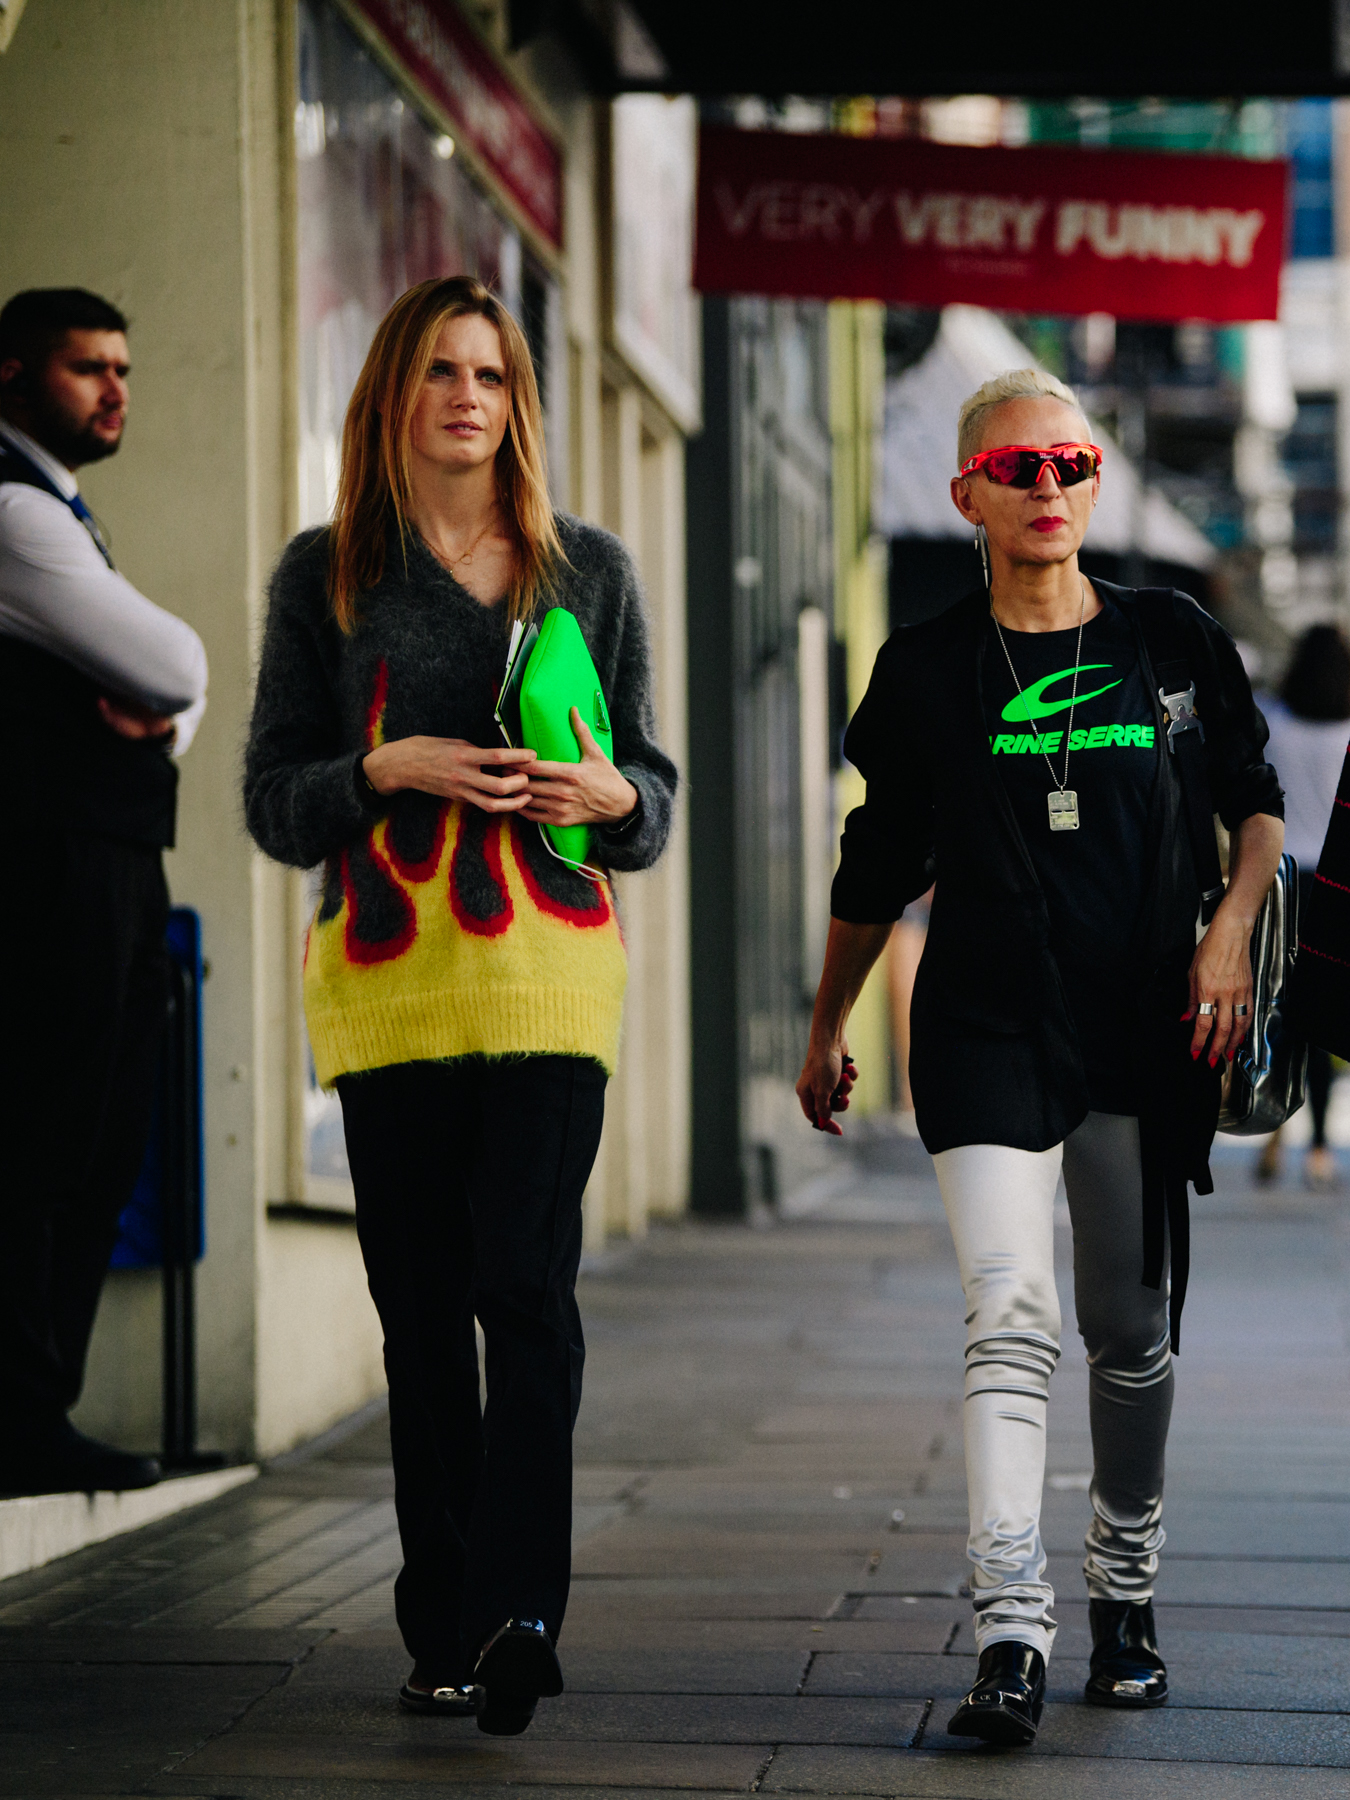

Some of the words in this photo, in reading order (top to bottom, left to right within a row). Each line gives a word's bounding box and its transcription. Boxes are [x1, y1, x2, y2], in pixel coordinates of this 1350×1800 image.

[714, 178, 888, 243] VERY
[893, 188, 1046, 252] VERY
[1056, 198, 1264, 268] FUNNY
[989, 731, 1064, 754] RINE
[1068, 724, 1154, 750] SERRE
[520, 1620, 533, 1628] 205
